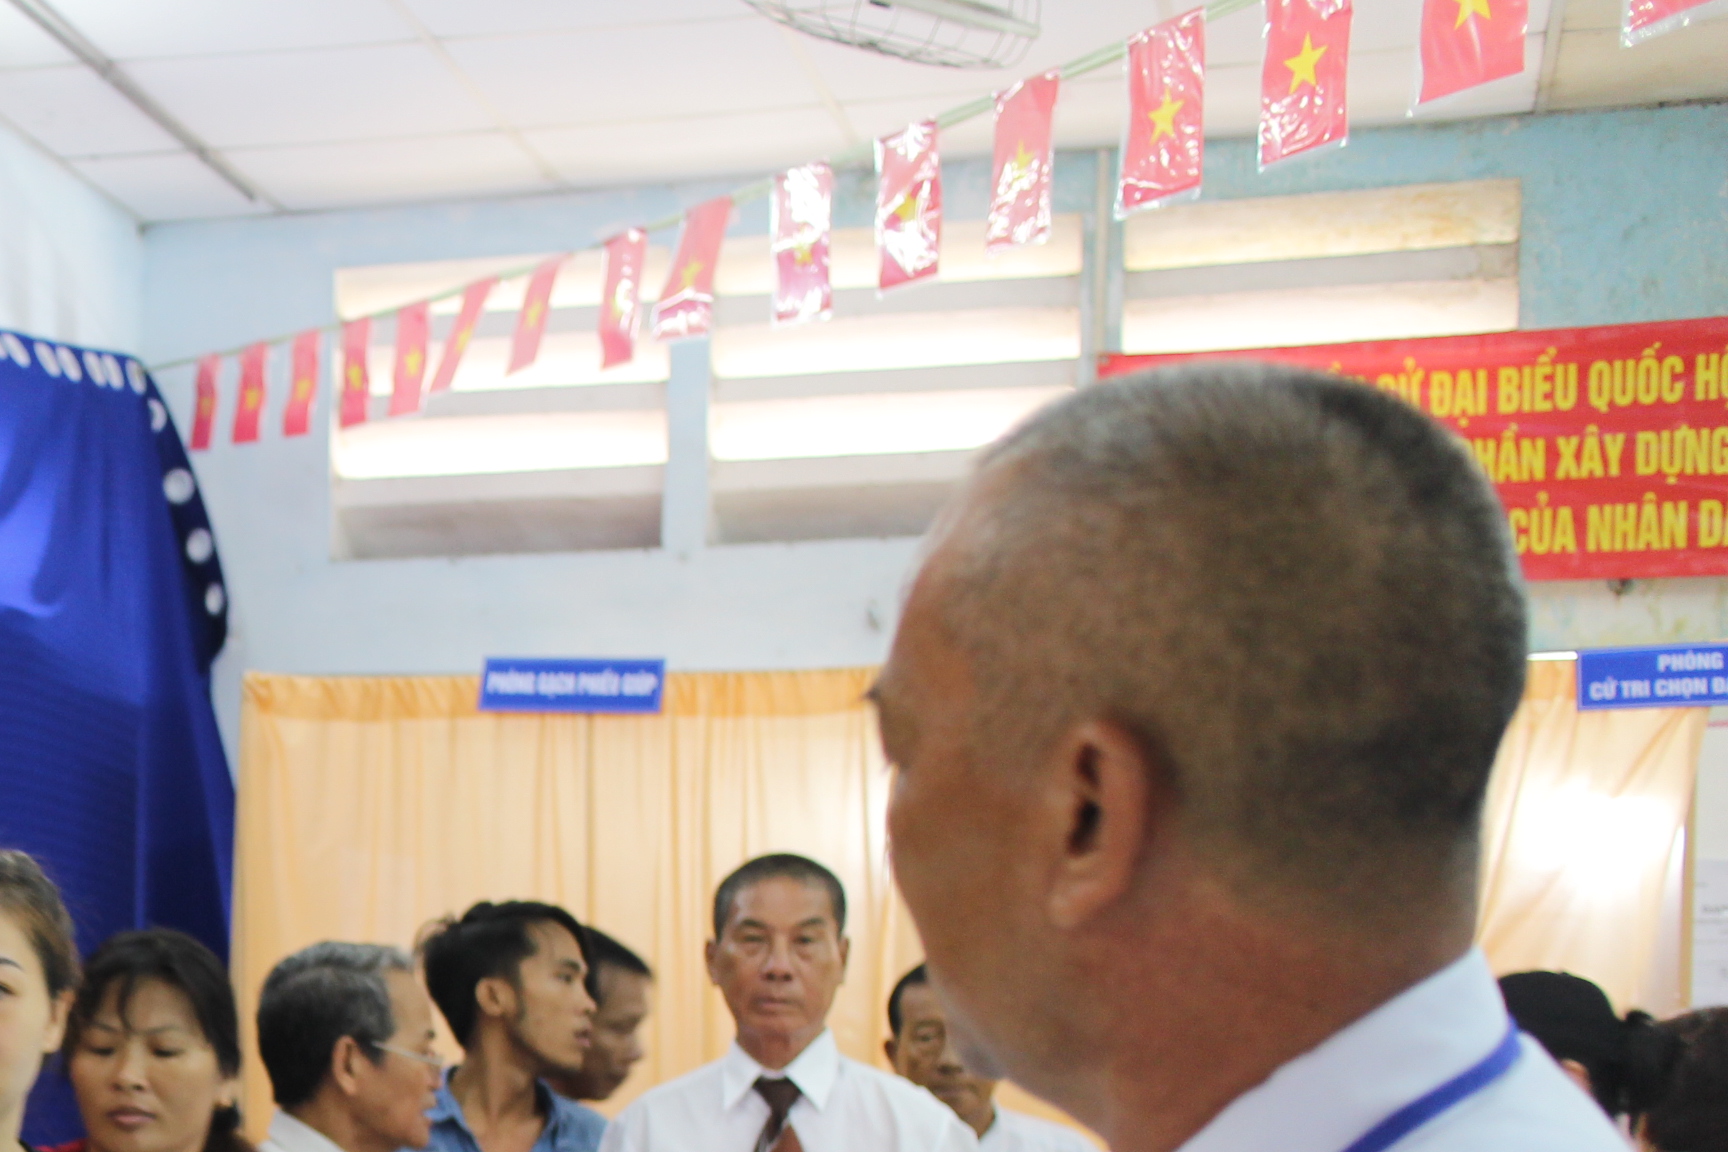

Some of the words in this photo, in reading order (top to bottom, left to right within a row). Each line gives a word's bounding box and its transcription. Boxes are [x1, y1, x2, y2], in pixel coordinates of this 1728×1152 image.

[1428, 367, 1489, 428] ĐẠI
[1497, 346, 1579, 415] BIỂU
[1588, 341, 1685, 414] QUỐC
[1555, 423, 1627, 481] XÂY
[1509, 491, 1576, 555] CỦA
[1587, 490, 1690, 553] NHÂN
[1588, 675, 1619, 701] CỬ
[1619, 679, 1652, 699] TRI
[1653, 676, 1710, 699] CHỌN
[1656, 650, 1725, 673] PHÒNG
